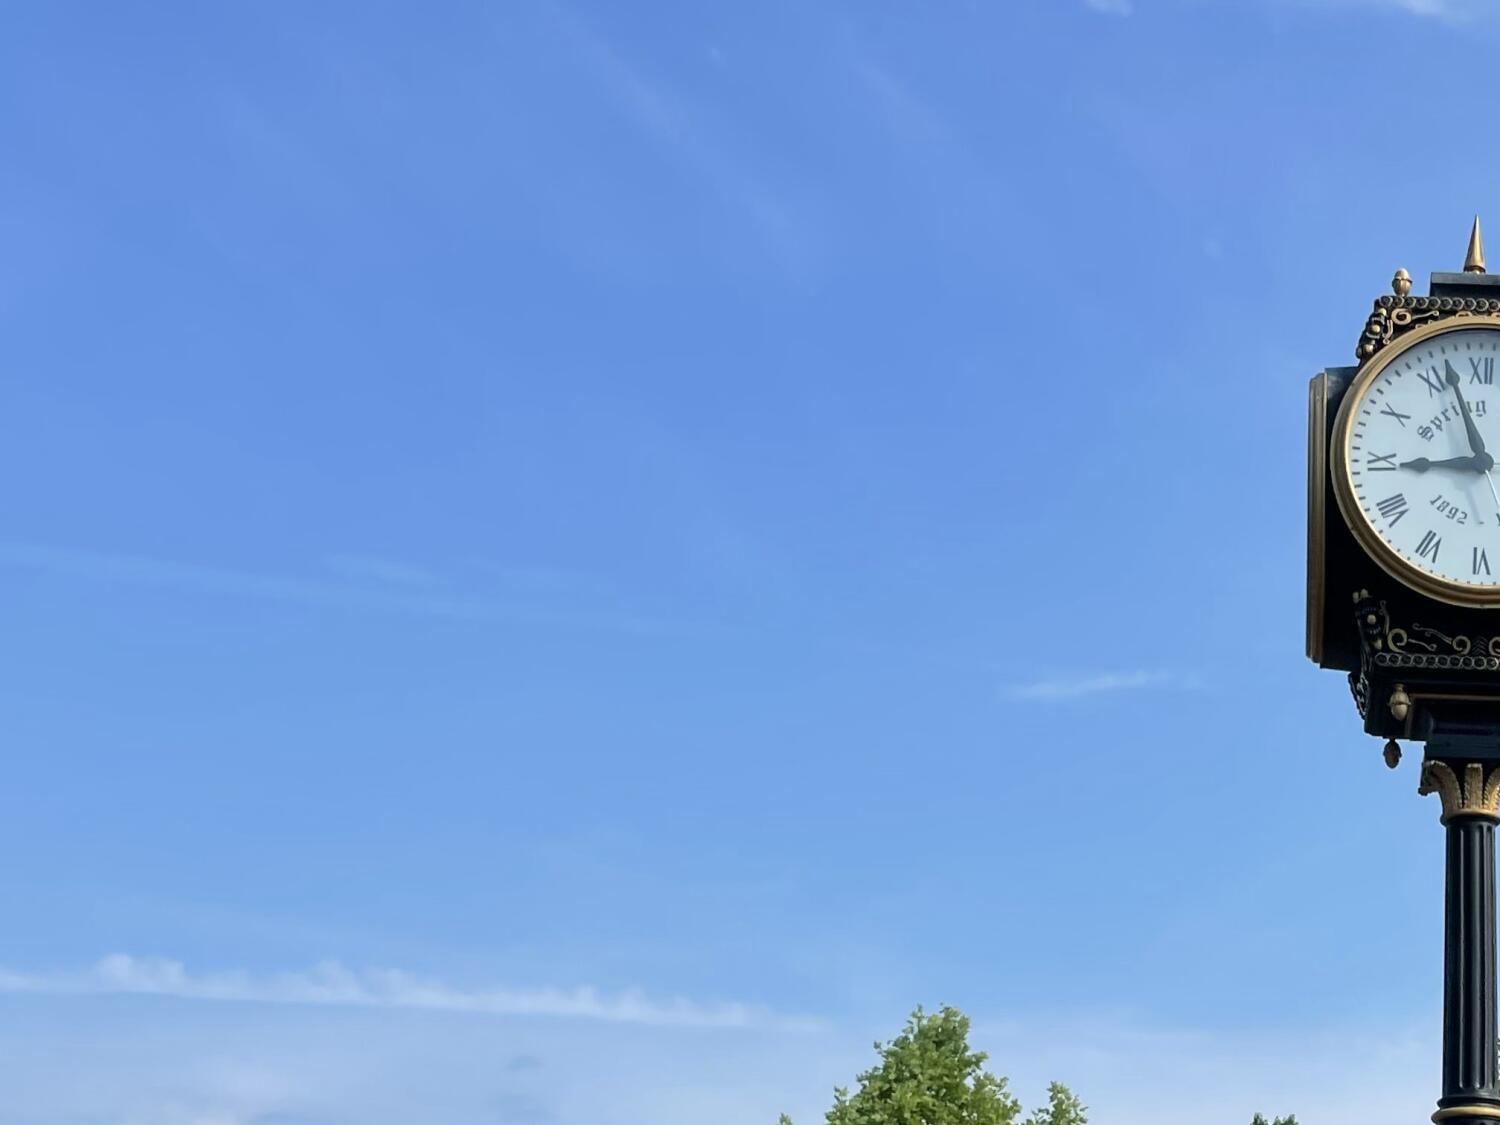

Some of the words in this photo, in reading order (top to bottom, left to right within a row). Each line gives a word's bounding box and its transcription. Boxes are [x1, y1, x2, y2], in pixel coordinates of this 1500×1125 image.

[1468, 356, 1494, 385] XII
[1380, 402, 1411, 428] X
[1367, 452, 1397, 471] IX
[1376, 493, 1410, 529] VIII
[1430, 494, 1468, 525] 1892
[1415, 530, 1442, 563] VII
[1472, 547, 1491, 576] VI
